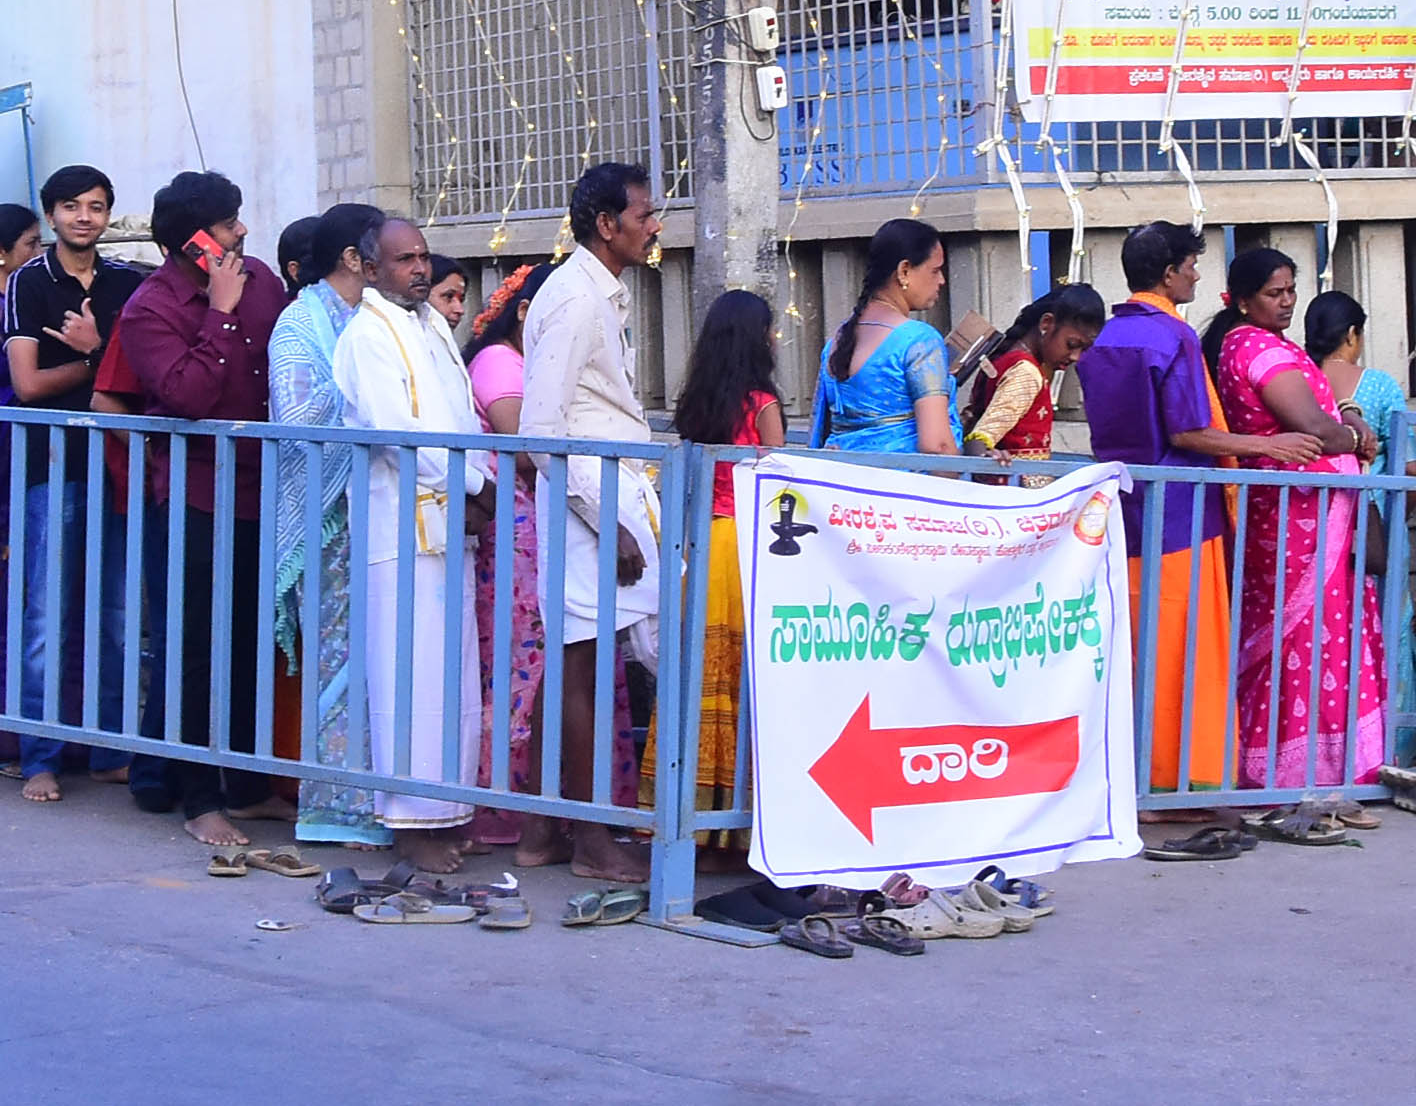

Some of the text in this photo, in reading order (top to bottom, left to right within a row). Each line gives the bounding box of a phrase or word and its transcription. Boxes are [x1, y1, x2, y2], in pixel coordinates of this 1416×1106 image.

[1105, 6, 1152, 21] ಸಮಯ
[1206, 6, 1242, 21] 5.00
[828, 502, 898, 542] ವೀರಶೈವ
[770, 584, 936, 663] ಸಾಮೂಹಿಕ
[899, 738, 1009, 785] ದಾರಿ
